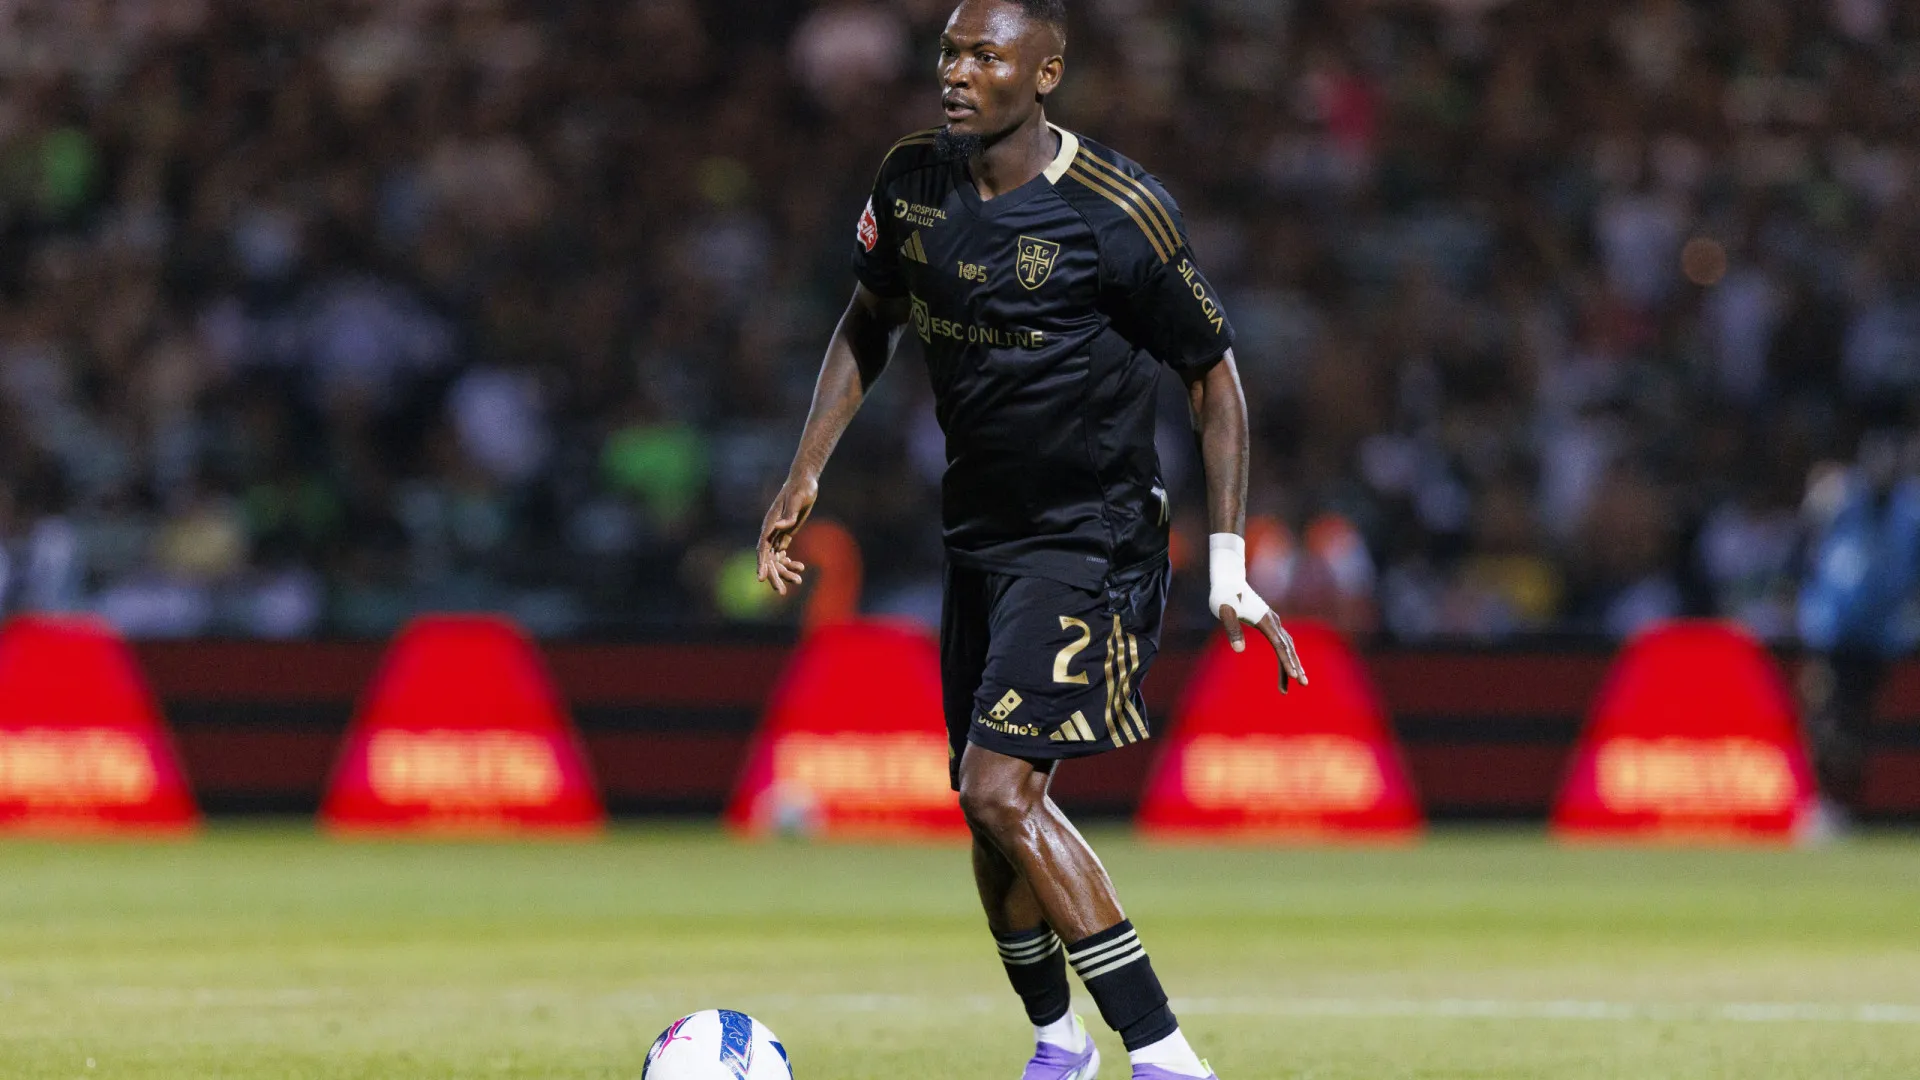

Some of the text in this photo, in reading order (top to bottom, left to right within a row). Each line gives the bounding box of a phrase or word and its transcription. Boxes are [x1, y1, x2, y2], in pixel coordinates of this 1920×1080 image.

[906, 213, 935, 228] DA LUZ
[910, 203, 947, 220] HOSPITAL
[1177, 258, 1223, 335] SILOGIA
[931, 317, 1043, 348] ESC ONLINE
[1053, 615, 1091, 684] 2
